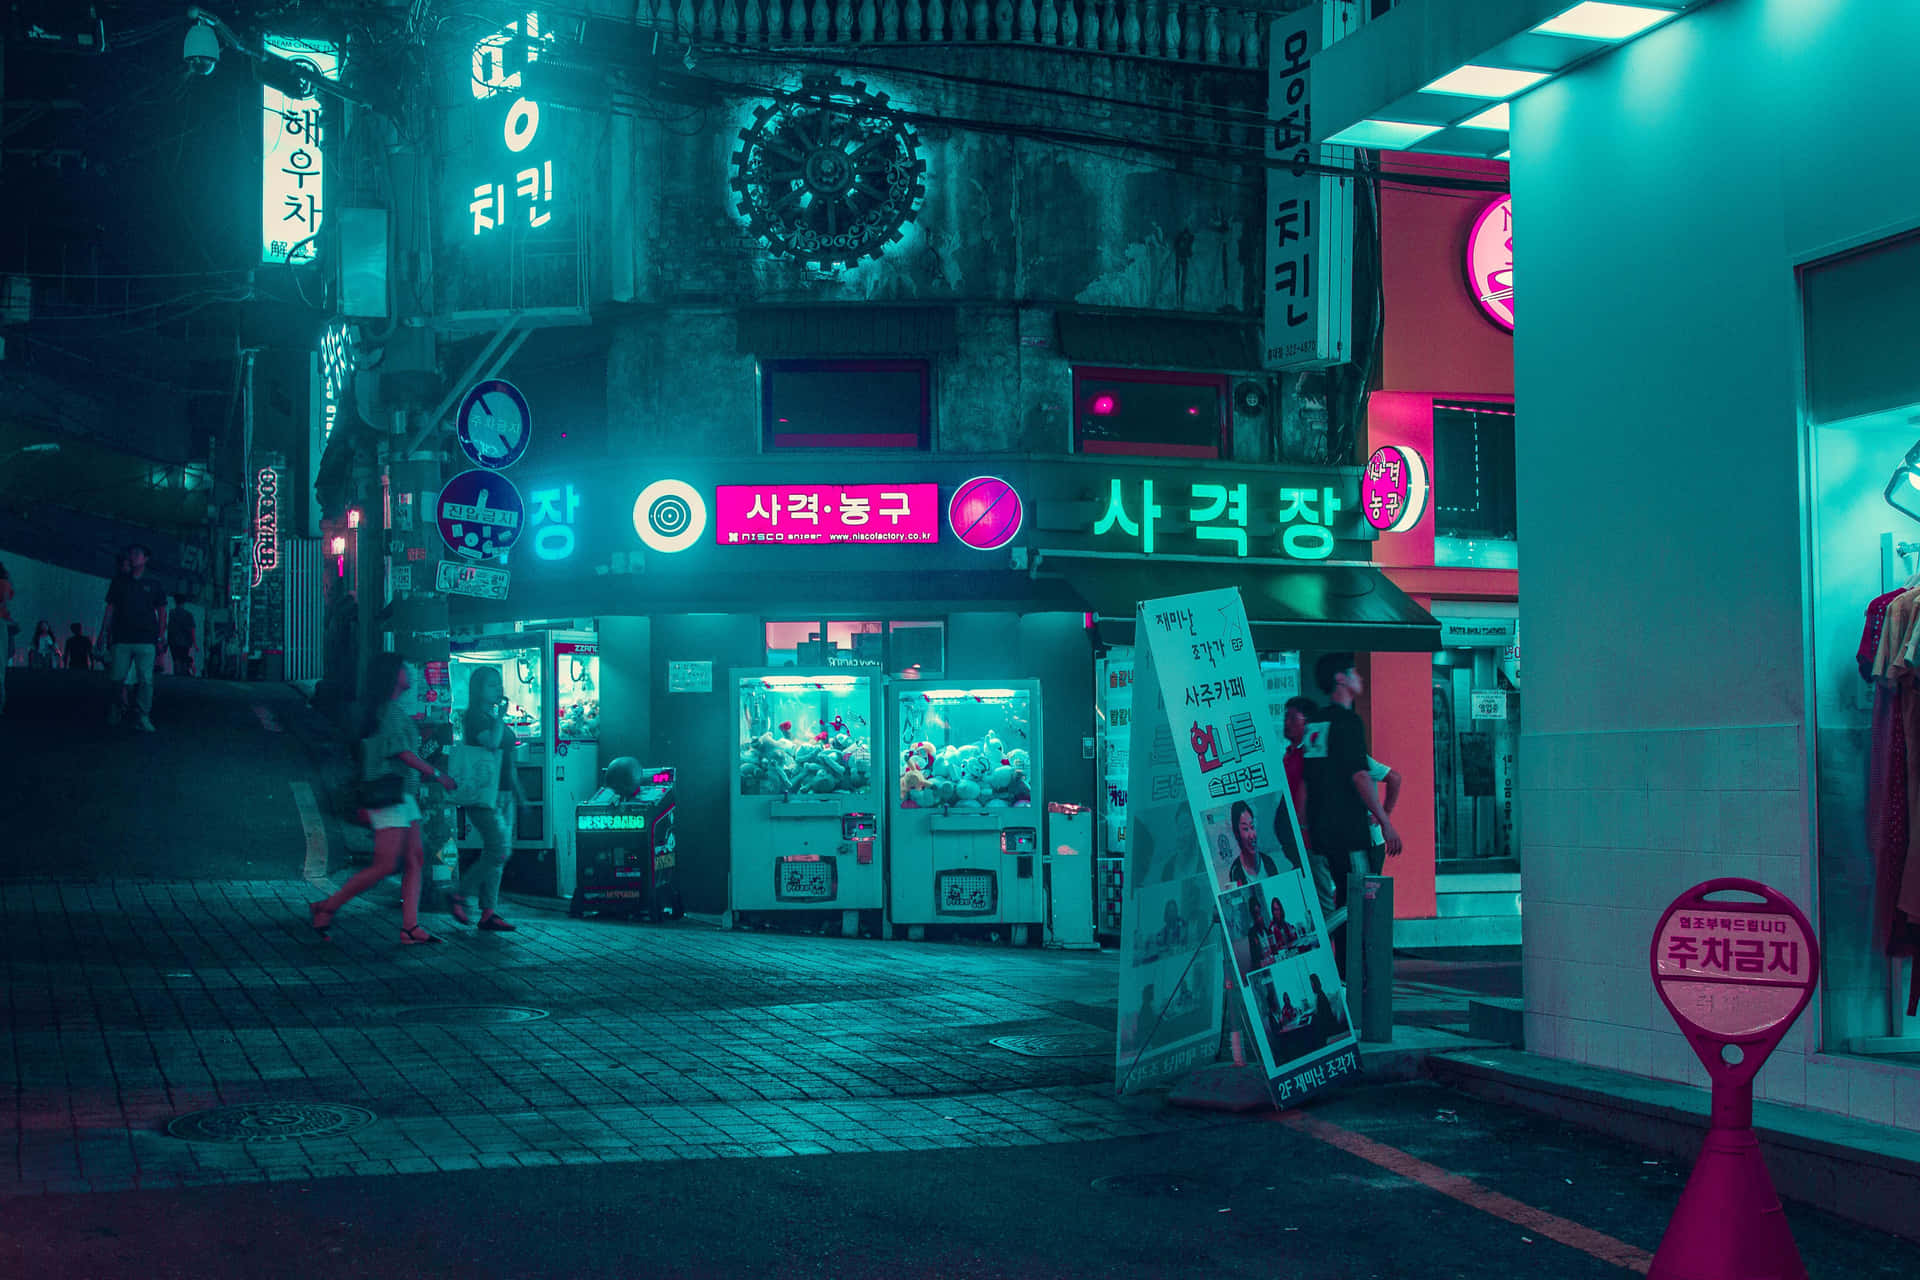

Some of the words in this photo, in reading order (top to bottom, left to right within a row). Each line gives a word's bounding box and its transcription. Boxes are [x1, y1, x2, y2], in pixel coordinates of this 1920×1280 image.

[281, 109, 323, 233] 해우차
[469, 159, 553, 236] 치킨
[1369, 459, 1401, 489] 사격
[448, 505, 514, 525] 진입금지
[1092, 477, 1343, 561] 사격장
[1368, 489, 1400, 521] 농구
[529, 484, 582, 562] 장
[1155, 607, 1197, 637] 재미난
[1191, 639, 1225, 669] 조각가
[1184, 676, 1247, 708] 사주카페
[1208, 762, 1269, 798] 슬램덩크
[1679, 916, 1787, 934] 협조부탁드립니다
[1667, 935, 1799, 976] 주차금지
[1277, 1081, 1292, 1100] 2F
[1295, 1065, 1326, 1093] 재미난
[1327, 1051, 1357, 1079] 조각가
